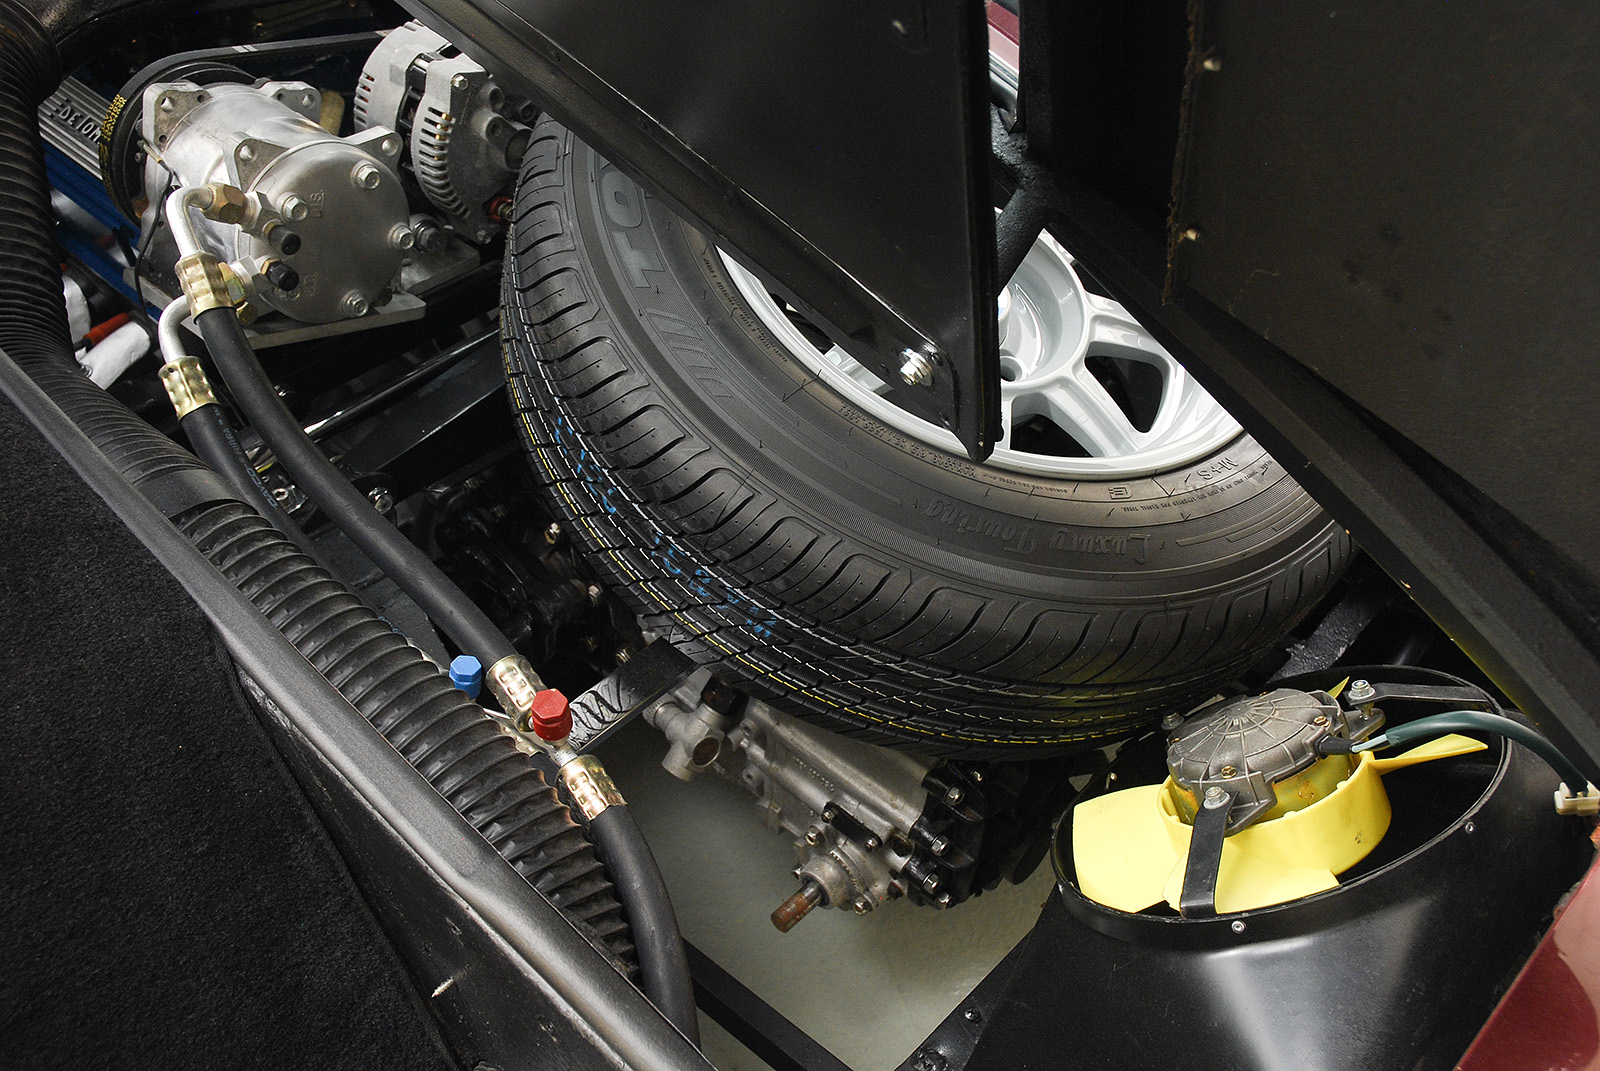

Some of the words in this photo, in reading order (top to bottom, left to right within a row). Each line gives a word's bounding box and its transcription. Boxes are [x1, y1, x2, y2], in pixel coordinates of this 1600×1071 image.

[58, 104, 101, 145] DETOM
[244, 464, 278, 510] DAYCO
[1197, 457, 1239, 480] M+S
[924, 498, 1036, 555] Touring
[1049, 527, 1151, 564] Luxury
